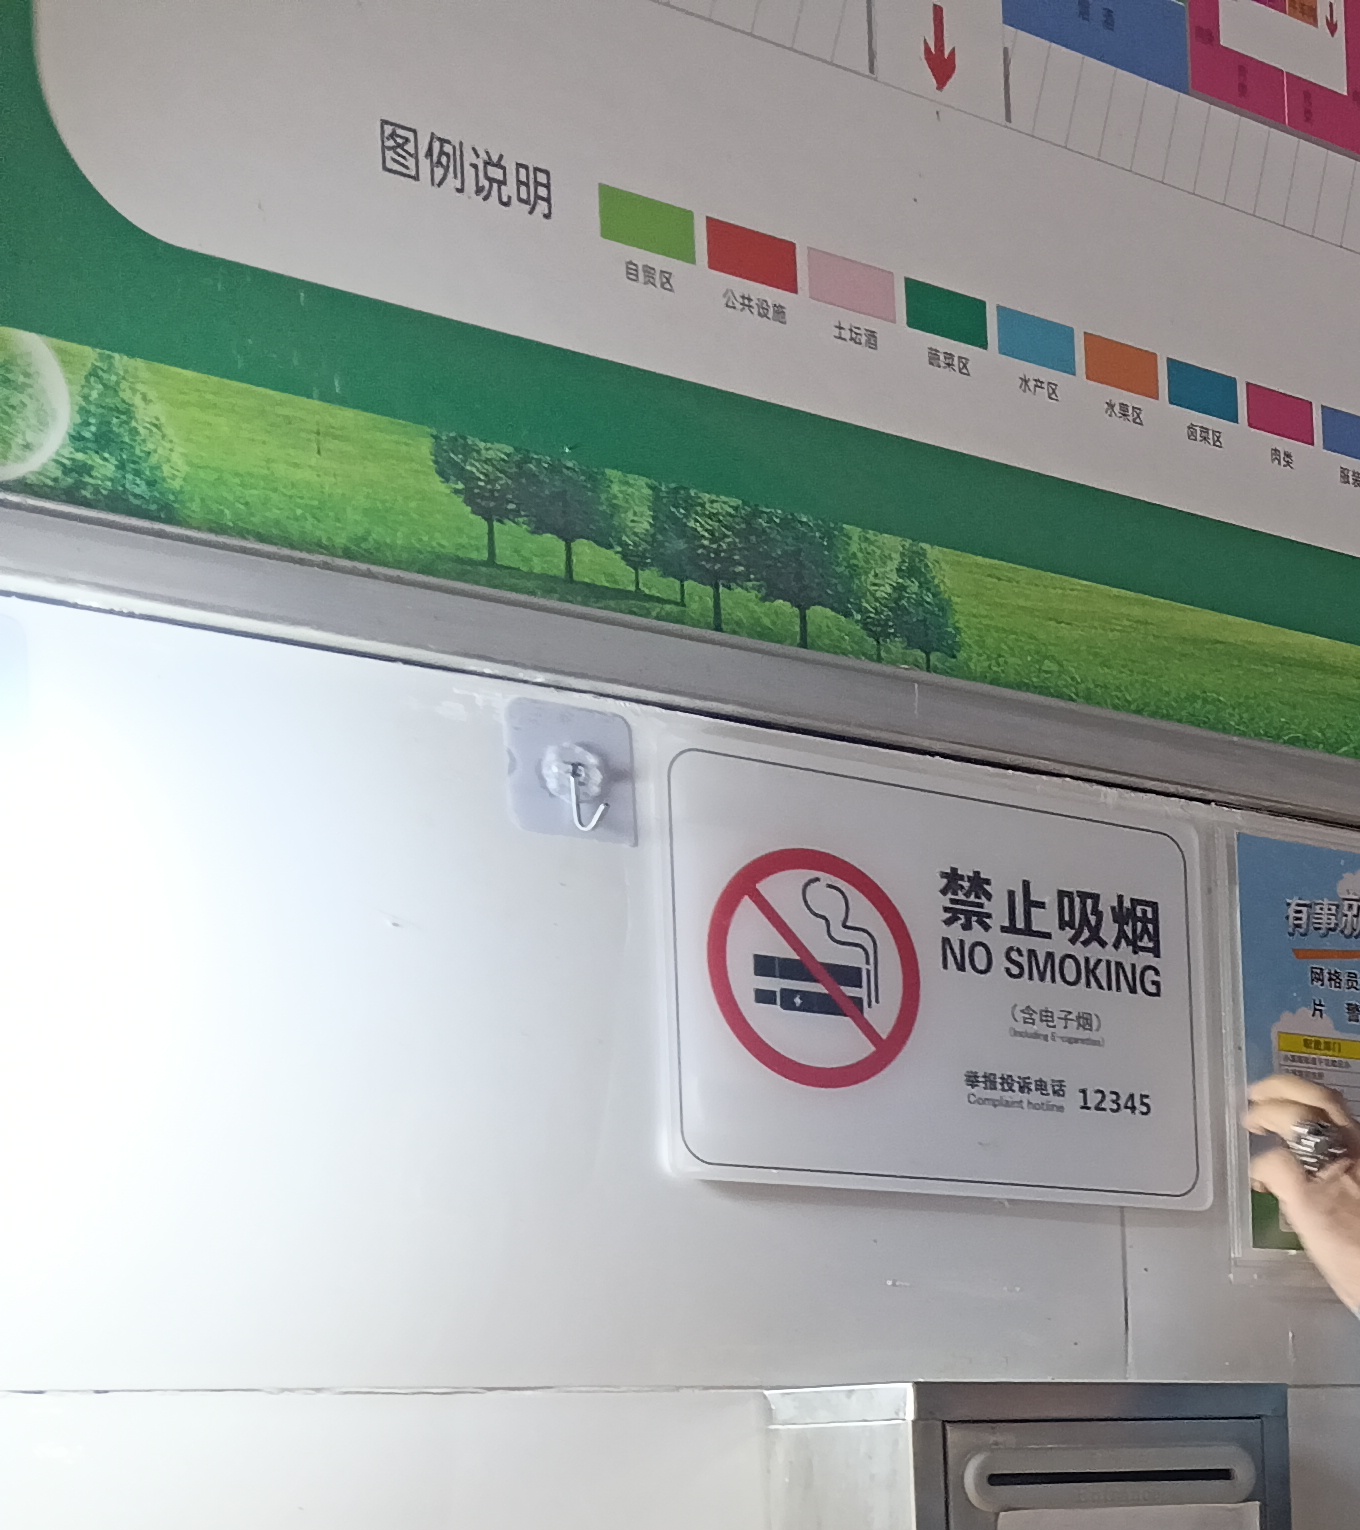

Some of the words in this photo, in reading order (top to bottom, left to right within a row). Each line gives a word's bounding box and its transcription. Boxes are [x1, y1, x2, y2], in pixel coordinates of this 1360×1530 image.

[380, 118, 552, 220] 图例说明
[625, 259, 675, 293] 自贸区
[722, 288, 788, 325] 公共设施
[833, 320, 879, 351] 土坛酒
[927, 346, 971, 377] 蔬菜区
[1018, 373, 1060, 403] 水产区
[1104, 399, 1144, 426] 水果区
[1186, 422, 1223, 449] 卤菜区
[1270, 446, 1294, 471] 肉类
[938, 865, 1162, 958] 禁止吸烟
[941, 935, 994, 976] NO
[1004, 944, 1162, 998] SMOKING
[964, 1070, 1067, 1098] 举报投诉电话
[1078, 1087, 1152, 1117] 12345
[967, 1092, 1025, 1110] Complaint
[1026, 1098, 1066, 1114] hotline
